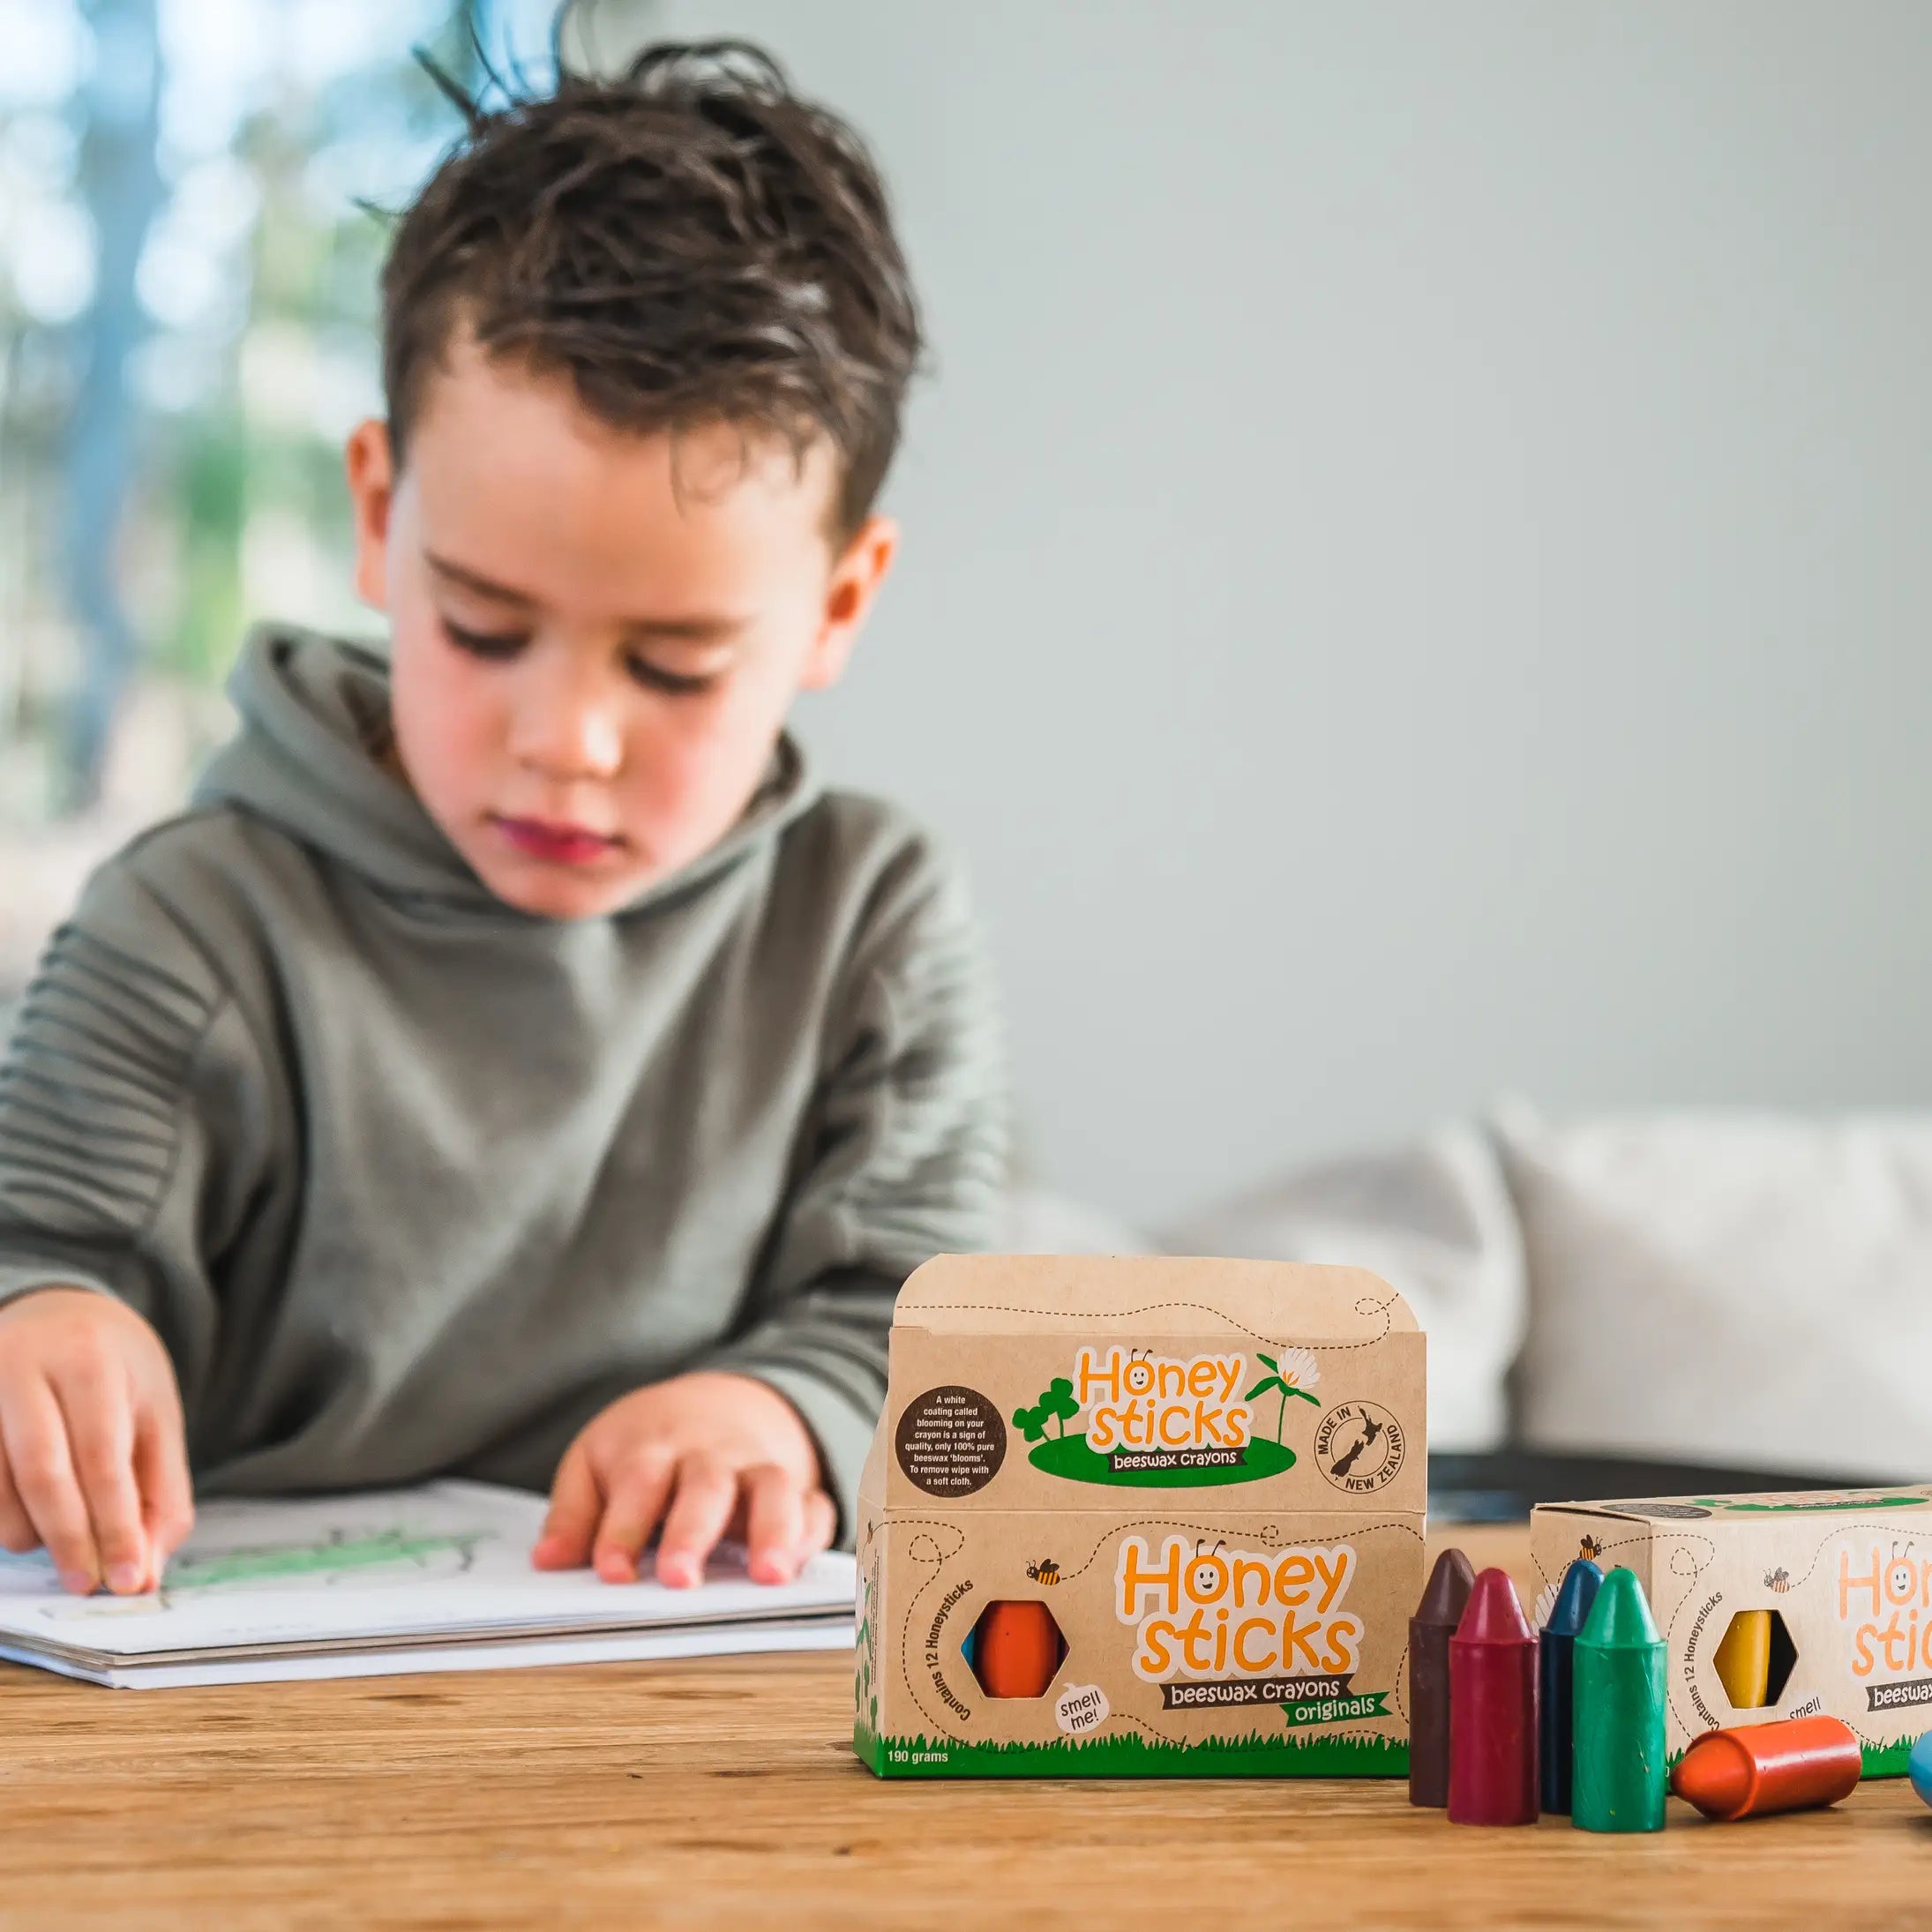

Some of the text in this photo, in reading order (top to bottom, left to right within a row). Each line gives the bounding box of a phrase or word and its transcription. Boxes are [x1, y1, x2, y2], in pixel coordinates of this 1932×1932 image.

[1079, 1352, 1241, 1404] Honey
[936, 1396, 966, 1404] A white
[917, 1419, 953, 1428] blooming
[967, 1420, 985, 1429] your
[924, 1408, 953, 1417] coating
[1091, 1398, 1248, 1447] sticks
[915, 1432, 941, 1441] crayon
[959, 1431, 976, 1441] sign
[1318, 1406, 1352, 1455] MADE IN
[905, 1442, 933, 1452] quality,
[934, 1442, 952, 1452] only
[977, 1443, 995, 1452] pure
[1345, 1425, 1402, 1491] NEW ZEALAND
[910, 1465, 918, 1474] To
[951, 1465, 970, 1475] wipe
[971, 1465, 989, 1474] with
[1114, 1451, 1237, 1470] beeswax crayons
[933, 1477, 948, 1486] soft
[950, 1477, 972, 1486] cloth.
[1123, 1543, 1348, 1615] Honey
[1683, 1591, 1723, 1662] Honeysticks
[925, 1579, 974, 1722] Contains 12 Honeysticks
[1140, 1607, 1356, 1674] sticks
[1684, 1666, 1695, 1683] 12
[1060, 1690, 1101, 1717] smell
[1172, 1681, 1341, 1705] beeswax crayons
[1294, 1697, 1375, 1721] originals
[1790, 1696, 1822, 1719] smell
[1071, 1708, 1099, 1731] me!
[887, 1750, 948, 1764] 190 grams
